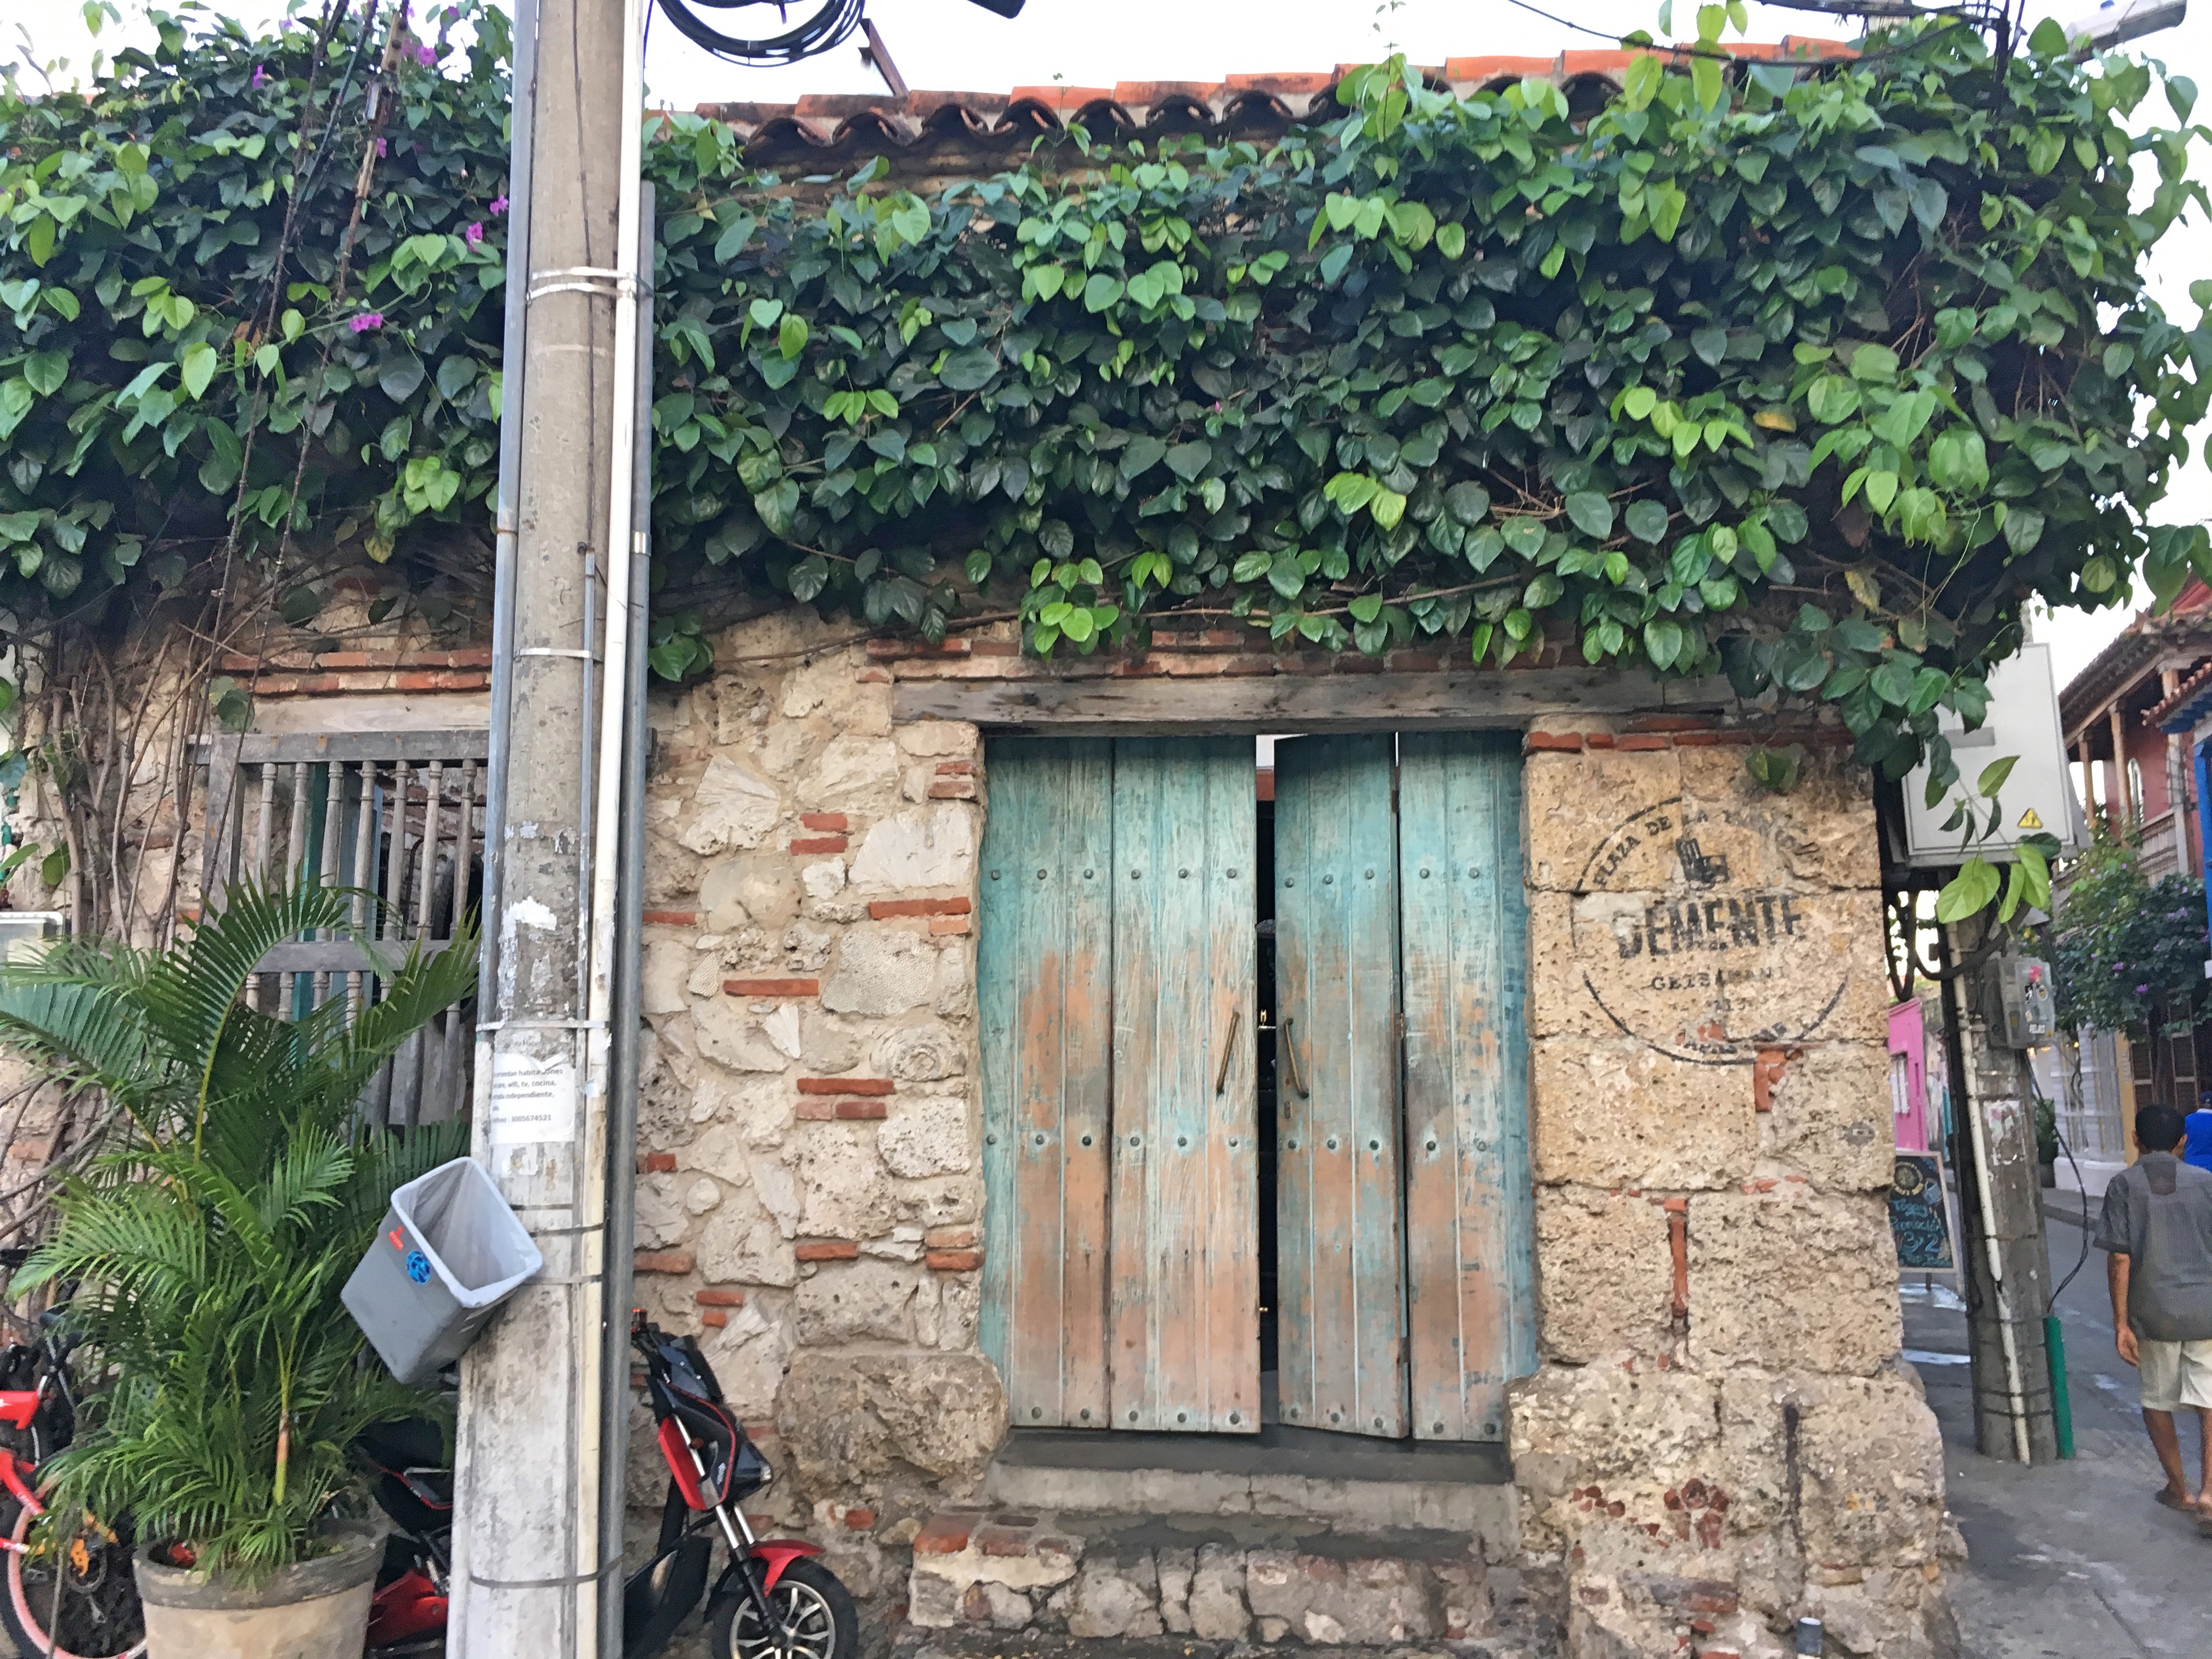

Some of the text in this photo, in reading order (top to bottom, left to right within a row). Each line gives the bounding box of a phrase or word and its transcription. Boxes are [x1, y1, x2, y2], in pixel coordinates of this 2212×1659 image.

[1593, 836, 1641, 888] PLAZA
[1645, 815, 1673, 837] DE
[505, 1091, 555, 1099] independiente,
